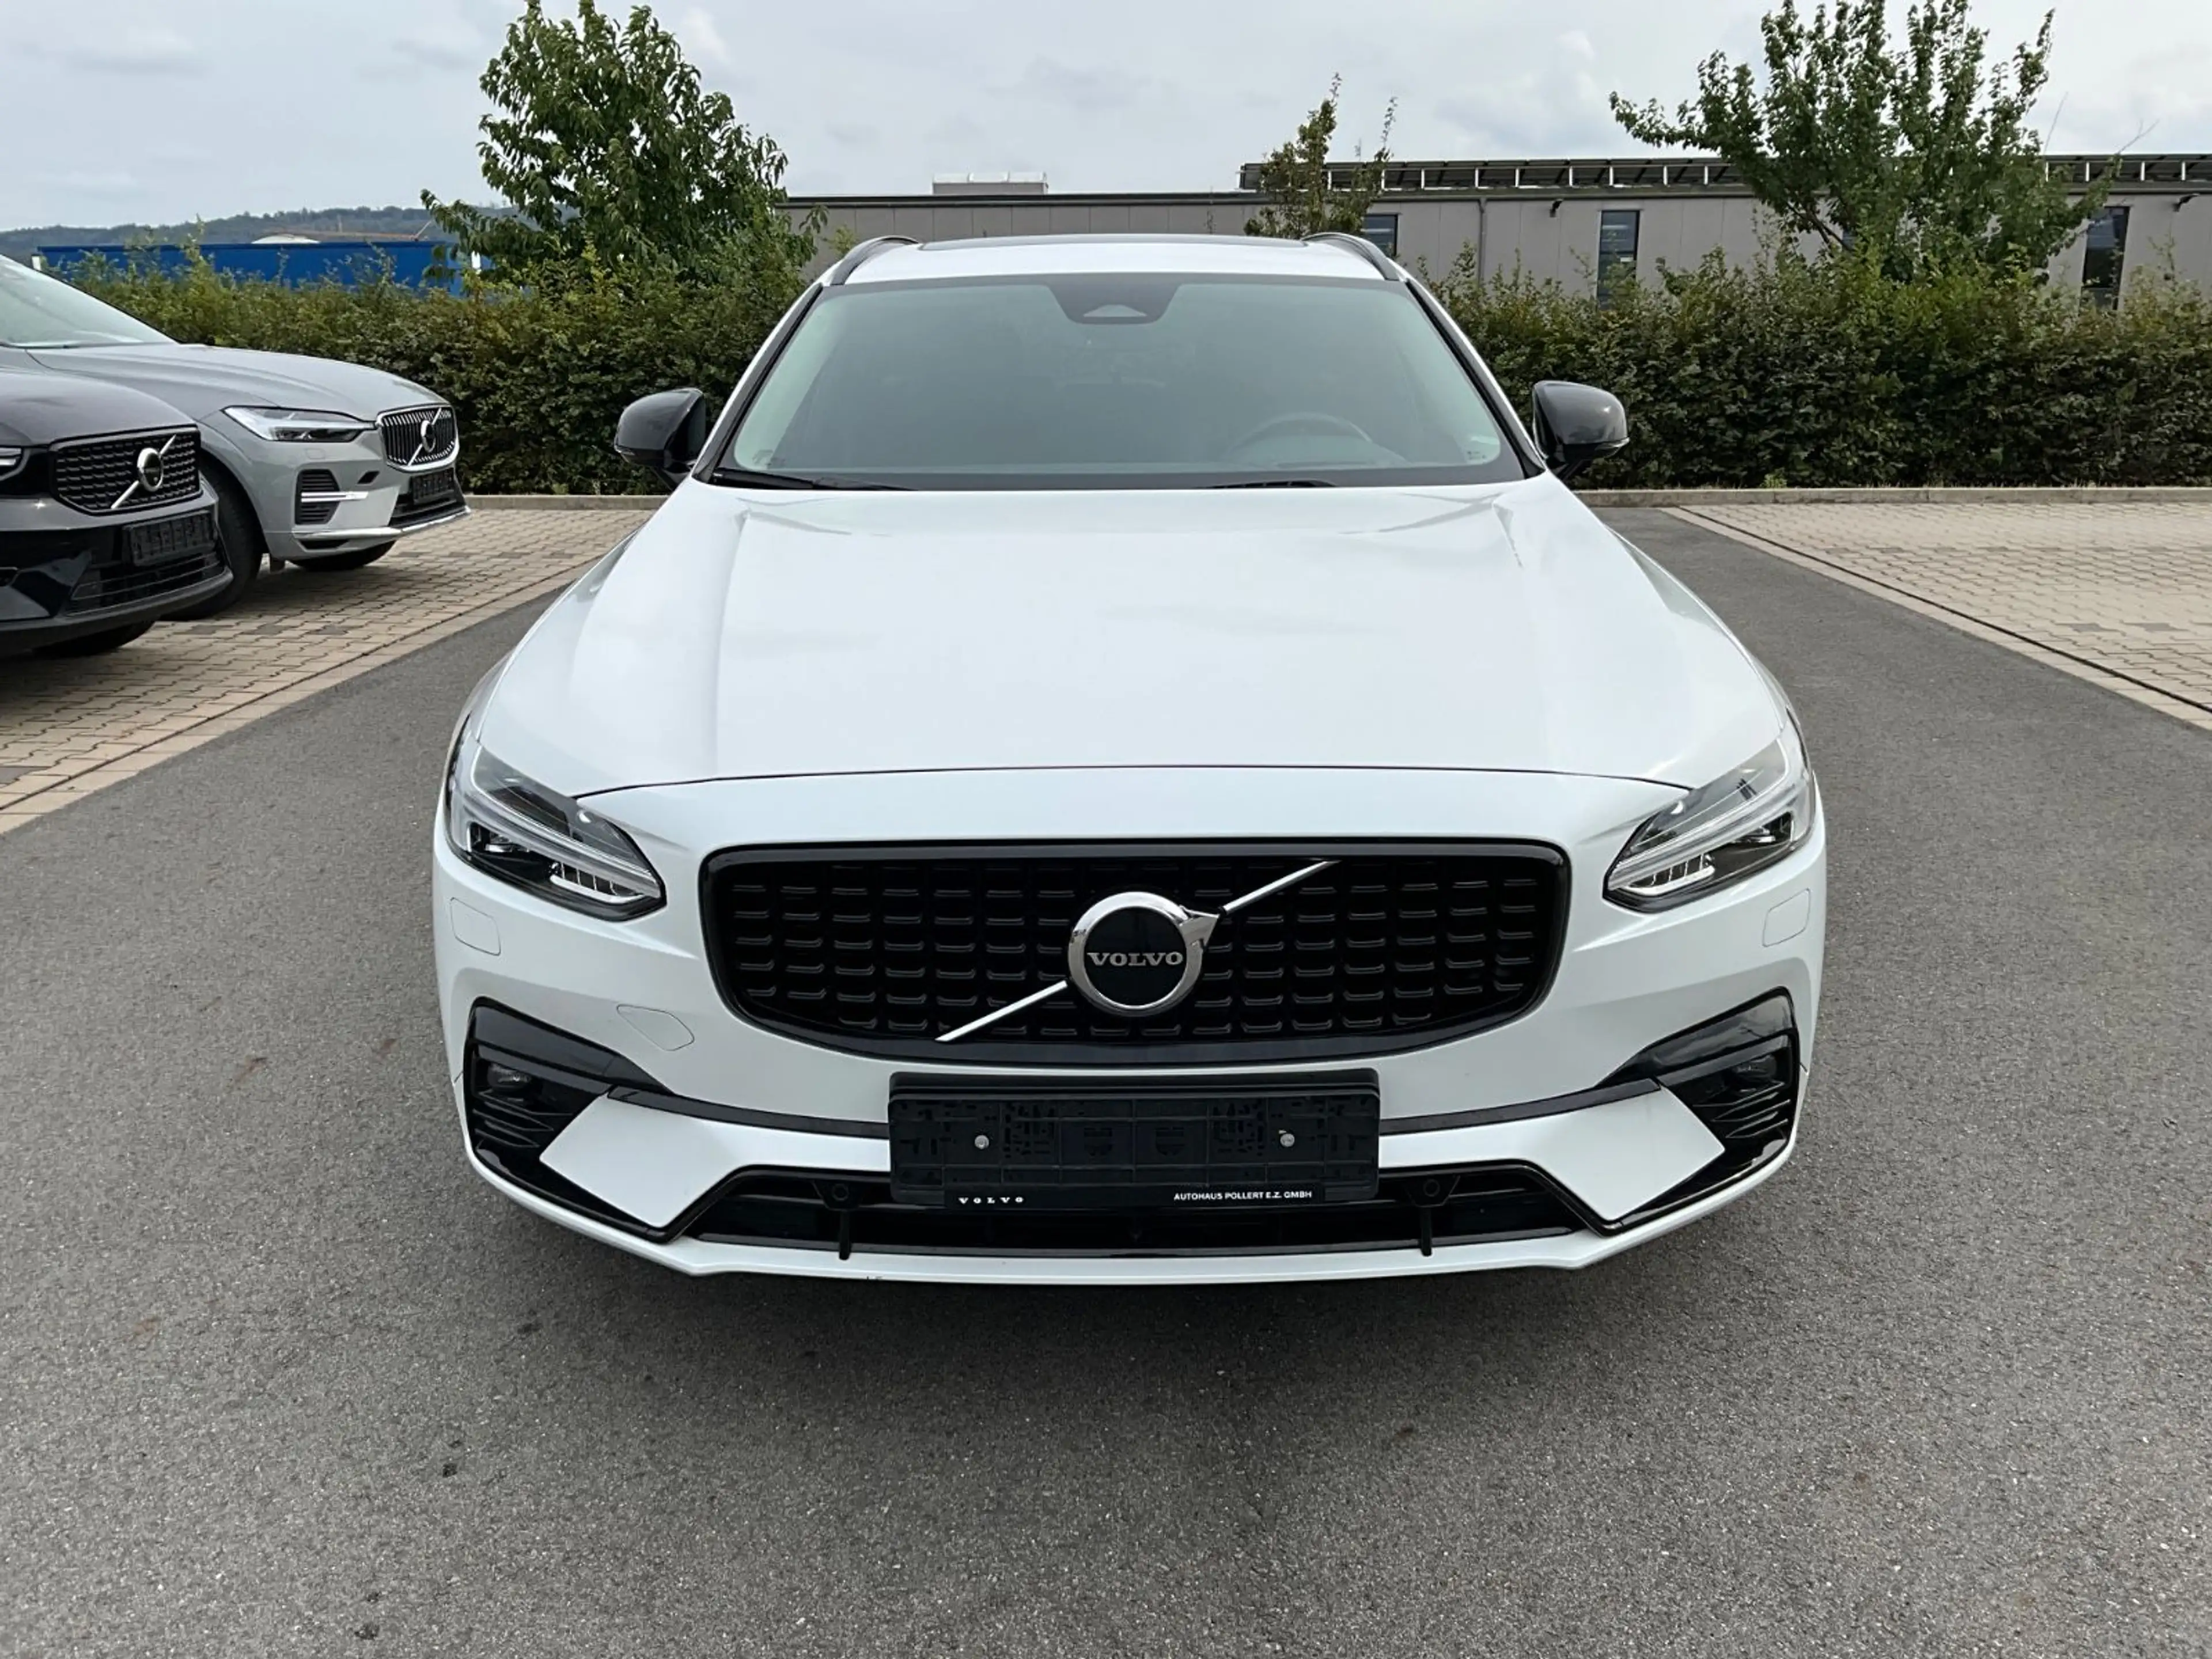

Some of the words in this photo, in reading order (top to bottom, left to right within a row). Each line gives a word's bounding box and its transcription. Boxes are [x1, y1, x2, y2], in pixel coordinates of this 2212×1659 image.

[1086, 951, 1183, 967] VOLVO
[1173, 1192, 1223, 1200] AUTOHAUS
[1224, 1191, 1264, 1199] POLLERT
[1283, 1190, 1312, 1198] GMBH
[958, 1196, 1024, 1205] VOLVO
